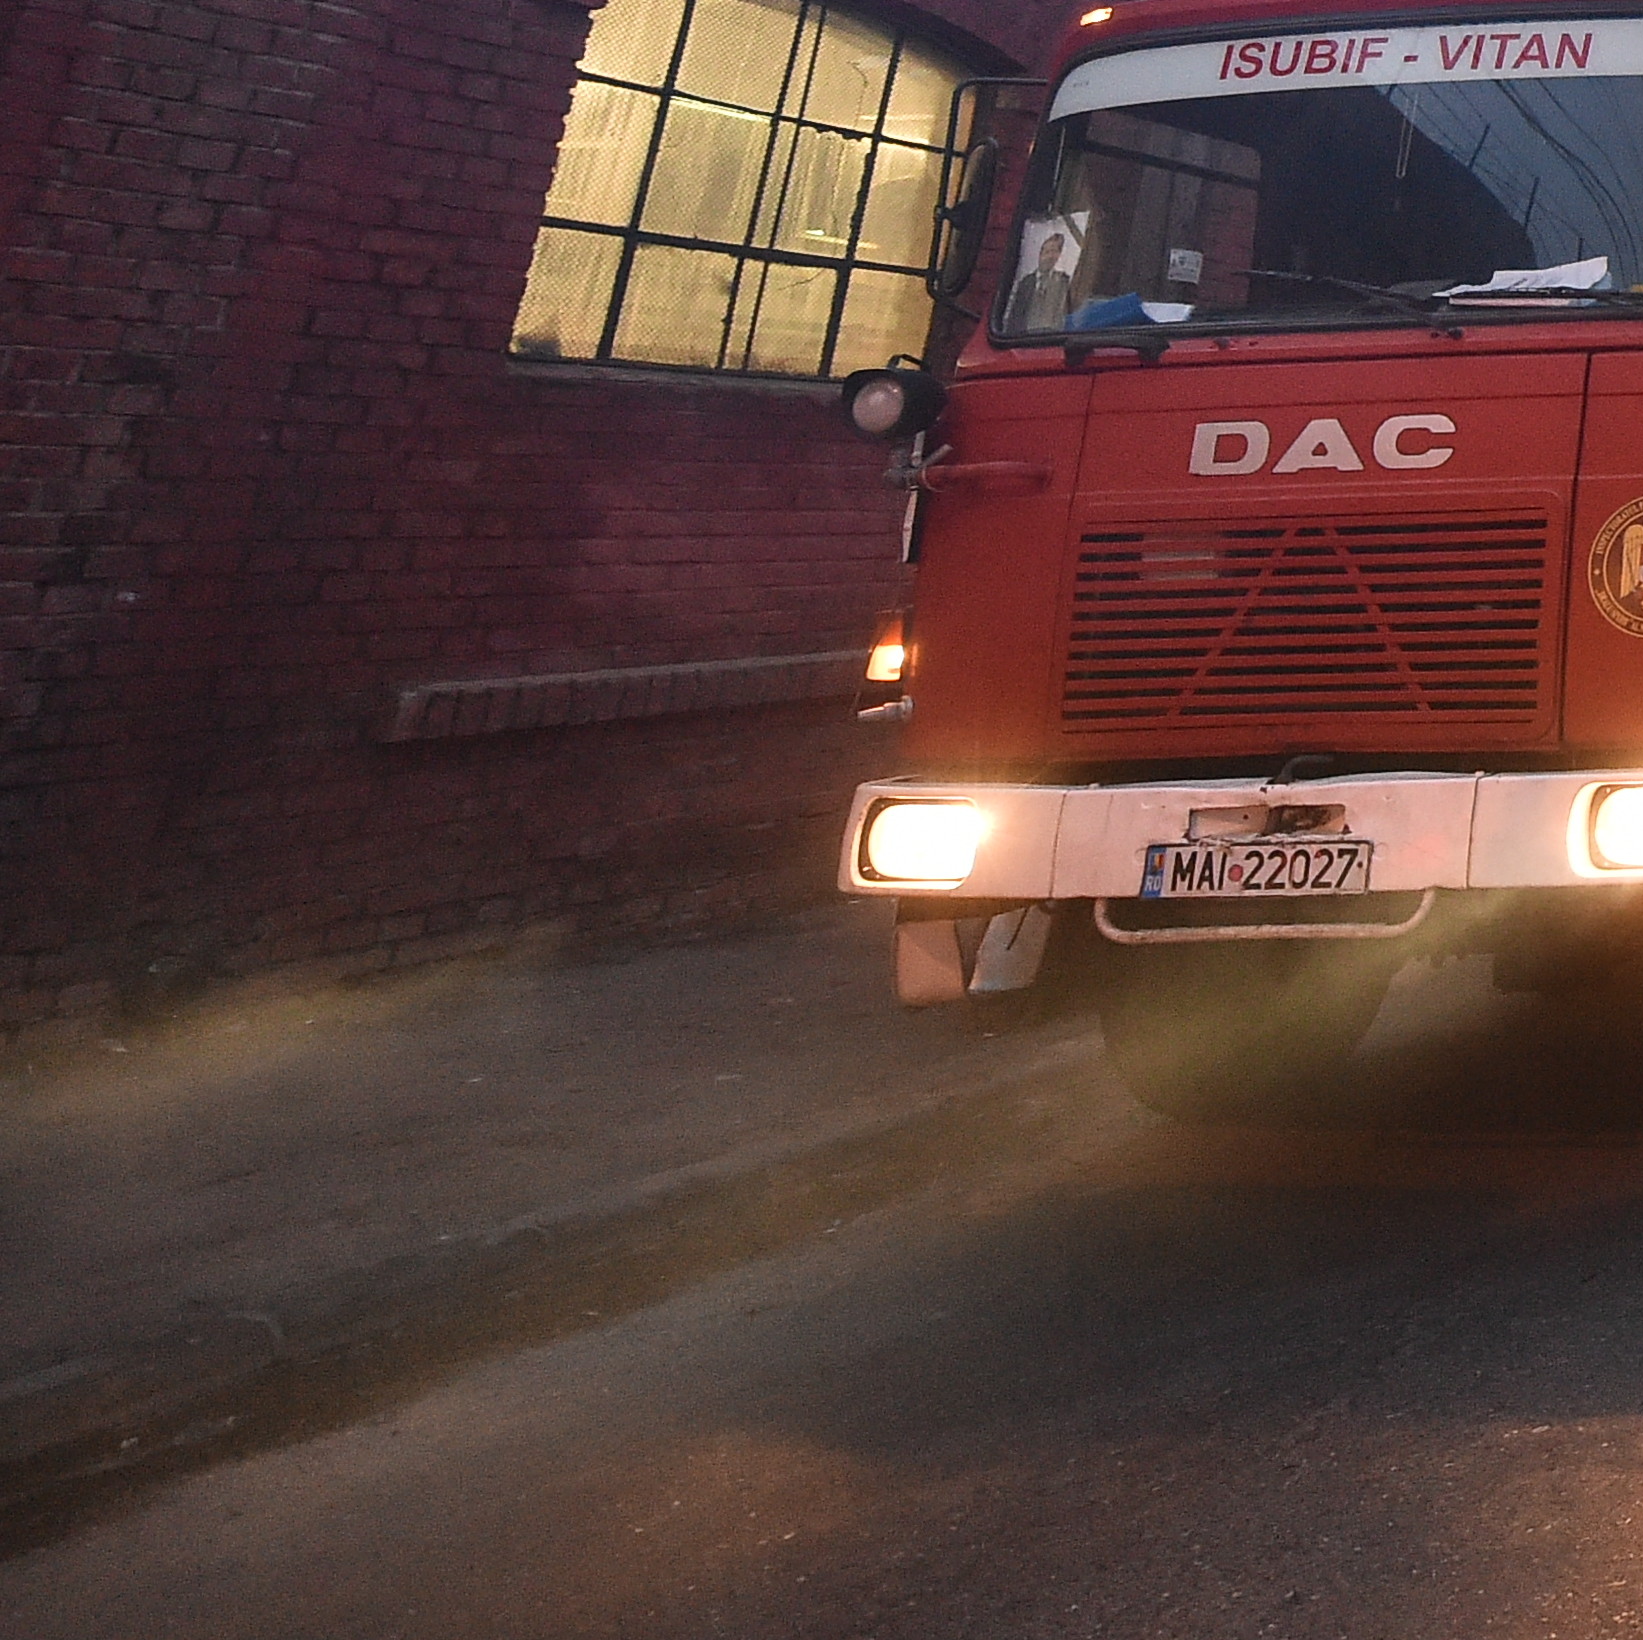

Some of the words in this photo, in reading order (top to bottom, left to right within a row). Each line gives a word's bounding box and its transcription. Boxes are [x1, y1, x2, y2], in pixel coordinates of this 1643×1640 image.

[1219, 36, 1389, 81] ISUBIF
[1439, 33, 1593, 71] VITAN
[1188, 414, 1456, 475] DAC
[1145, 875, 1163, 891] RO
[1170, 851, 1228, 892] MAI
[1242, 848, 1359, 891] 22027
